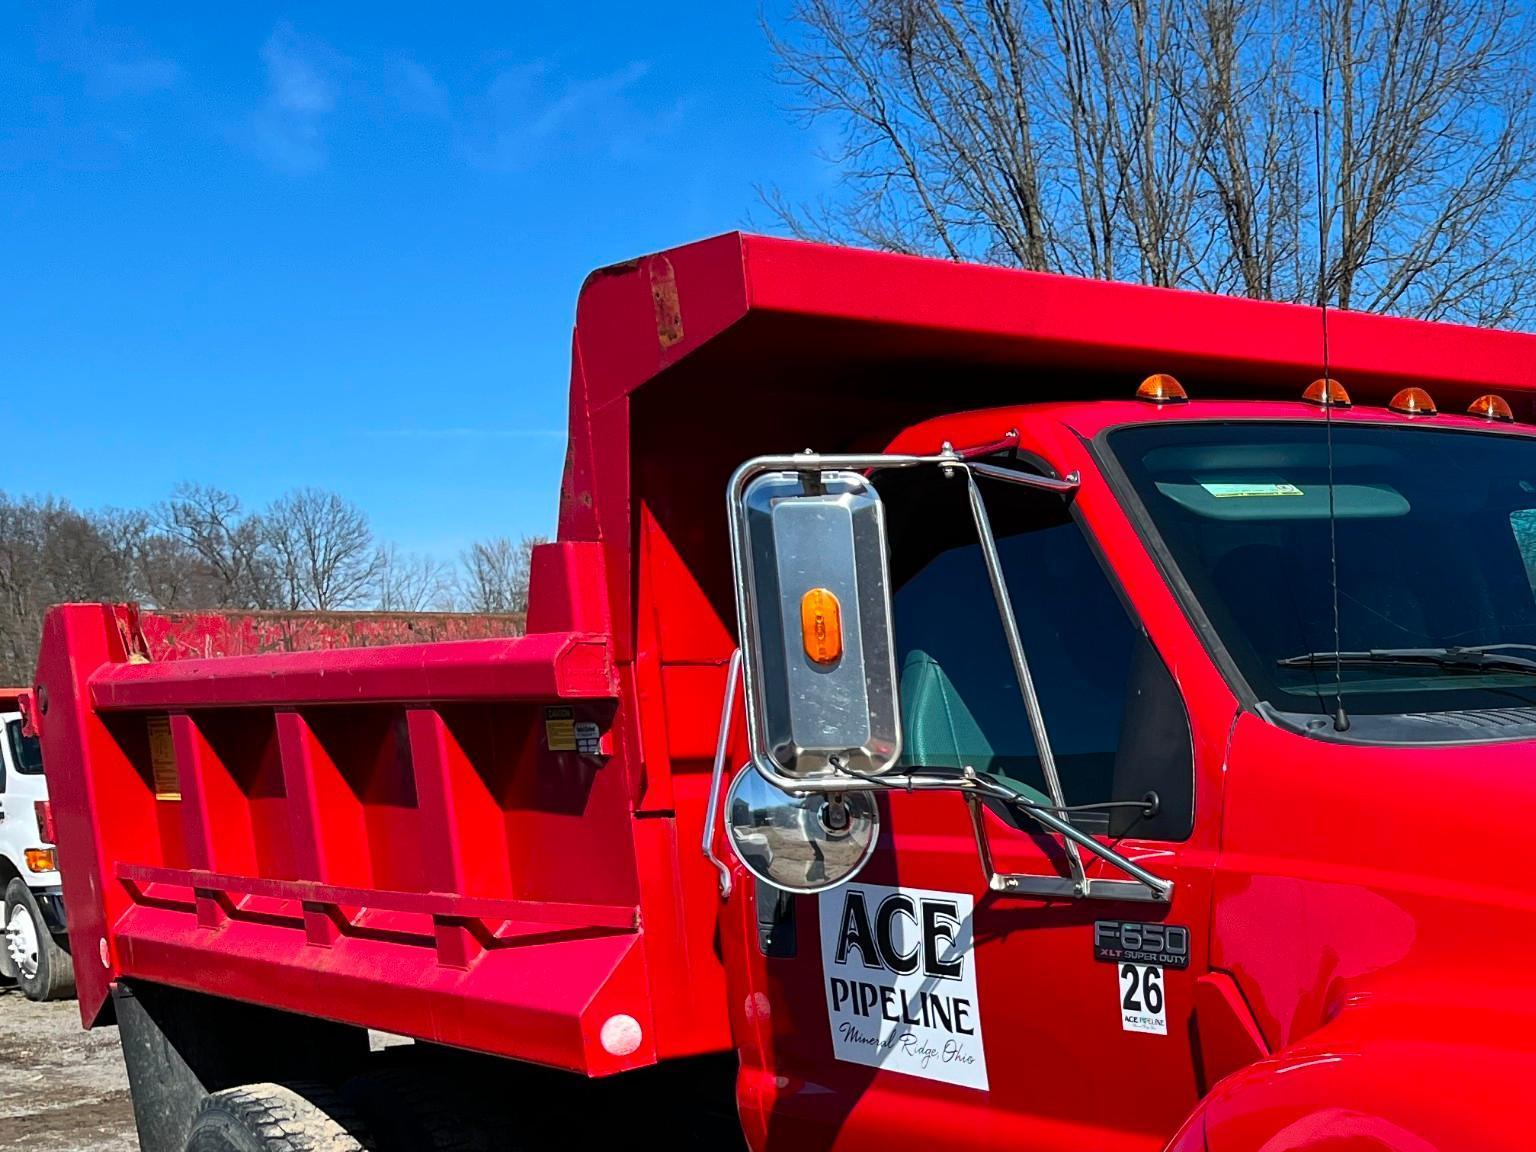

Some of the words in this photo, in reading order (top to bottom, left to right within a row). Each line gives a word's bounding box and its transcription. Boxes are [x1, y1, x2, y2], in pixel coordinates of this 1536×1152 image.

[834, 890, 963, 982] ACE
[1100, 949, 1122, 958] XLT
[1124, 951, 1157, 961] SUPER
[1159, 955, 1186, 964] DUTY
[830, 977, 975, 1036] PIPELINE
[1120, 963, 1163, 1015] 26
[838, 1021, 898, 1050] Mineral
[941, 1039, 976, 1066] Ohio
[1124, 1015, 1138, 1024] ACE
